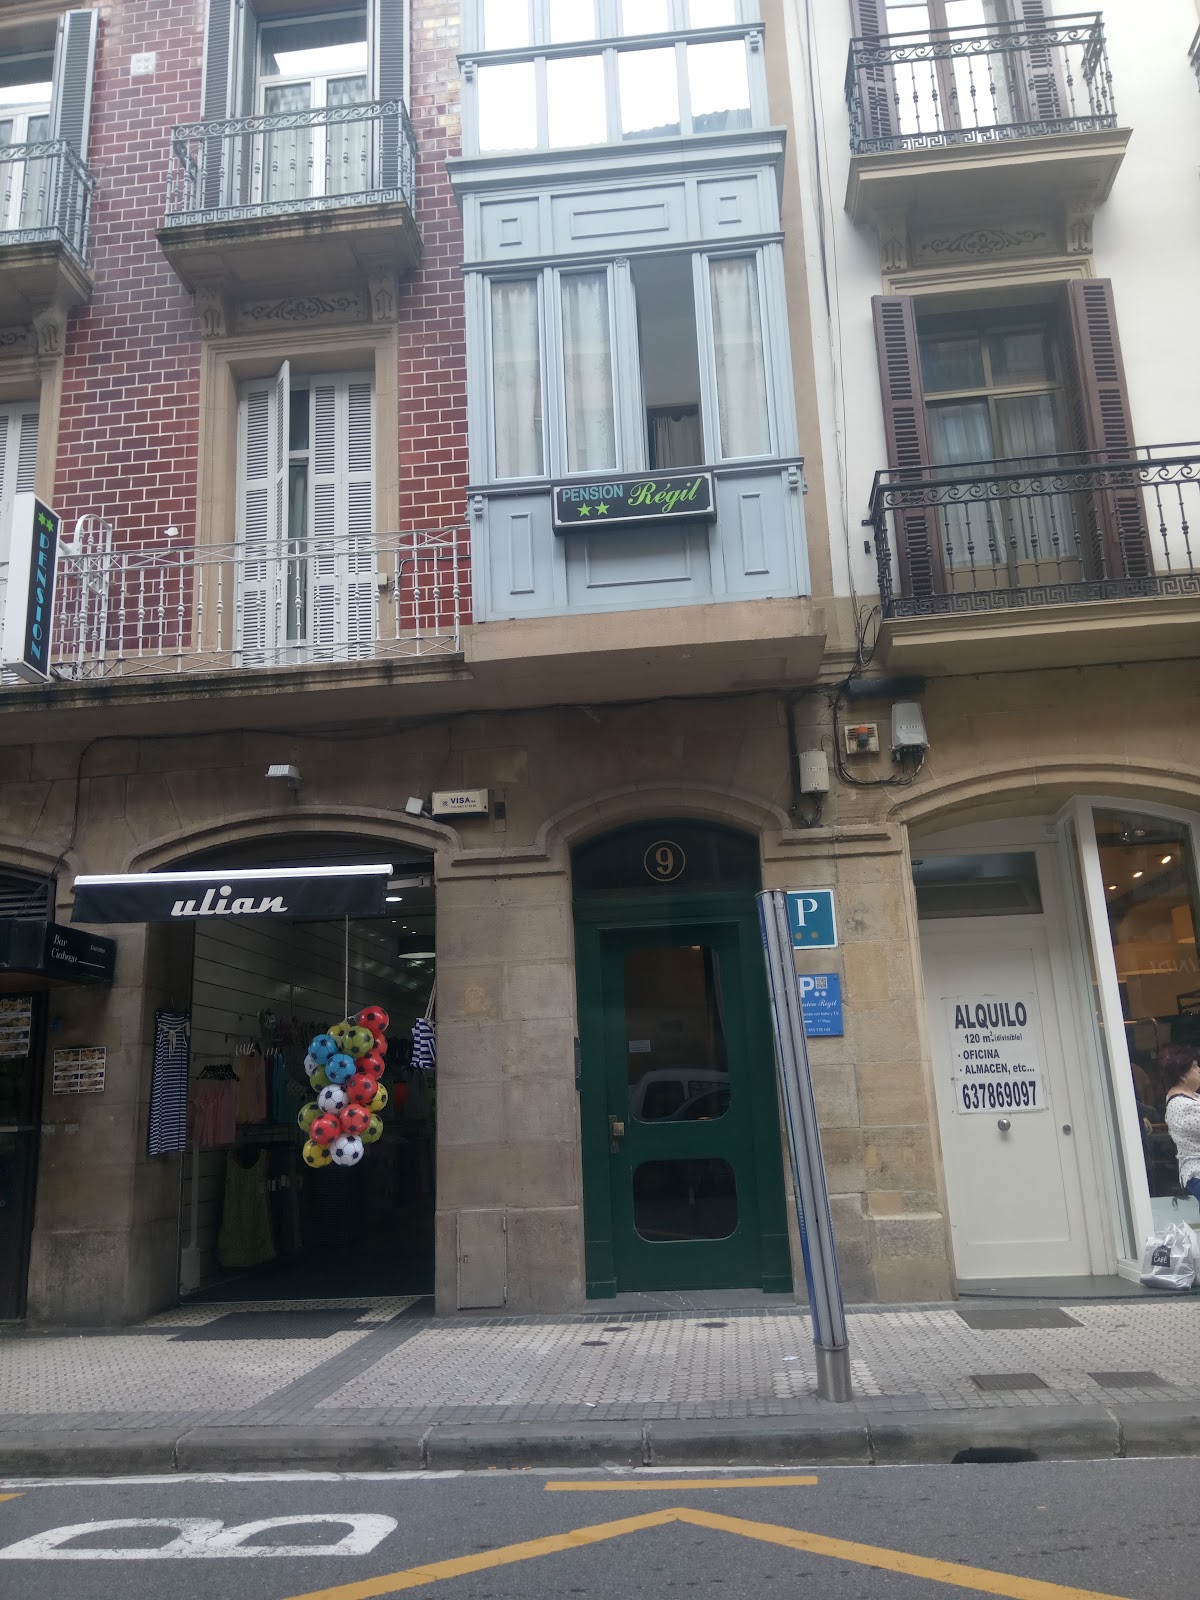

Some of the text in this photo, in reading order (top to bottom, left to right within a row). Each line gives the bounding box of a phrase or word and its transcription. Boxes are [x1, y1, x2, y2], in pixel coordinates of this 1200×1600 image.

[562, 477, 703, 513] PENSION Régil
[31, 532, 50, 661] PENSION
[655, 847, 674, 875] 9
[170, 885, 289, 917] ulian
[794, 898, 819, 927] P
[53, 934, 68, 947] Bar
[800, 977, 815, 998] P
[818, 999, 837, 1009] Régil
[955, 1002, 1027, 1029] ALQUILO
[964, 1033, 980, 1044] 120
[963, 1049, 1000, 1060] OFICINA
[965, 1063, 1011, 1075] ALMACEN,
[962, 1081, 1036, 1109] 637869097
